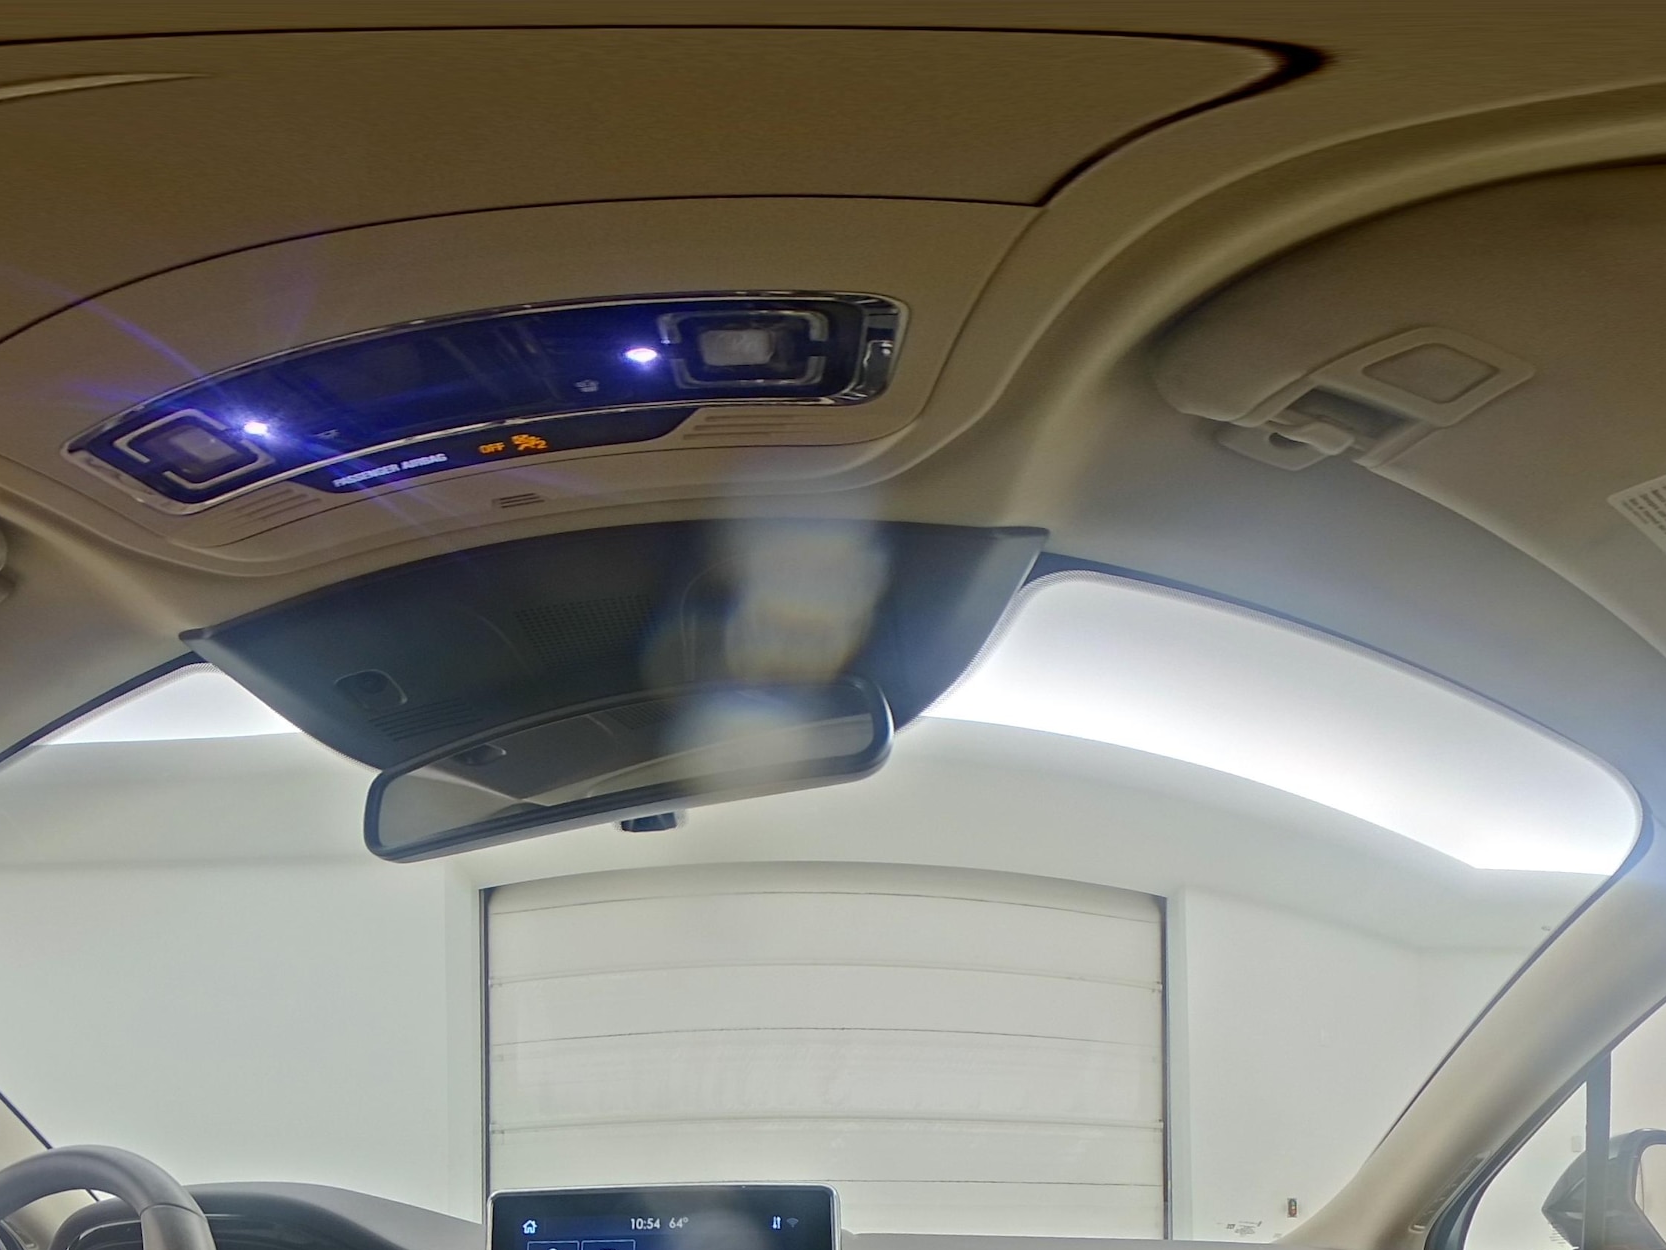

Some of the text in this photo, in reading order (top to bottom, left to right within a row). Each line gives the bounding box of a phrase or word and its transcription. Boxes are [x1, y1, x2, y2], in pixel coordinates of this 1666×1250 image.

[333, 453, 448, 487] PASSENGER AIRBAG
[631, 1218, 661, 1230] 10:54
